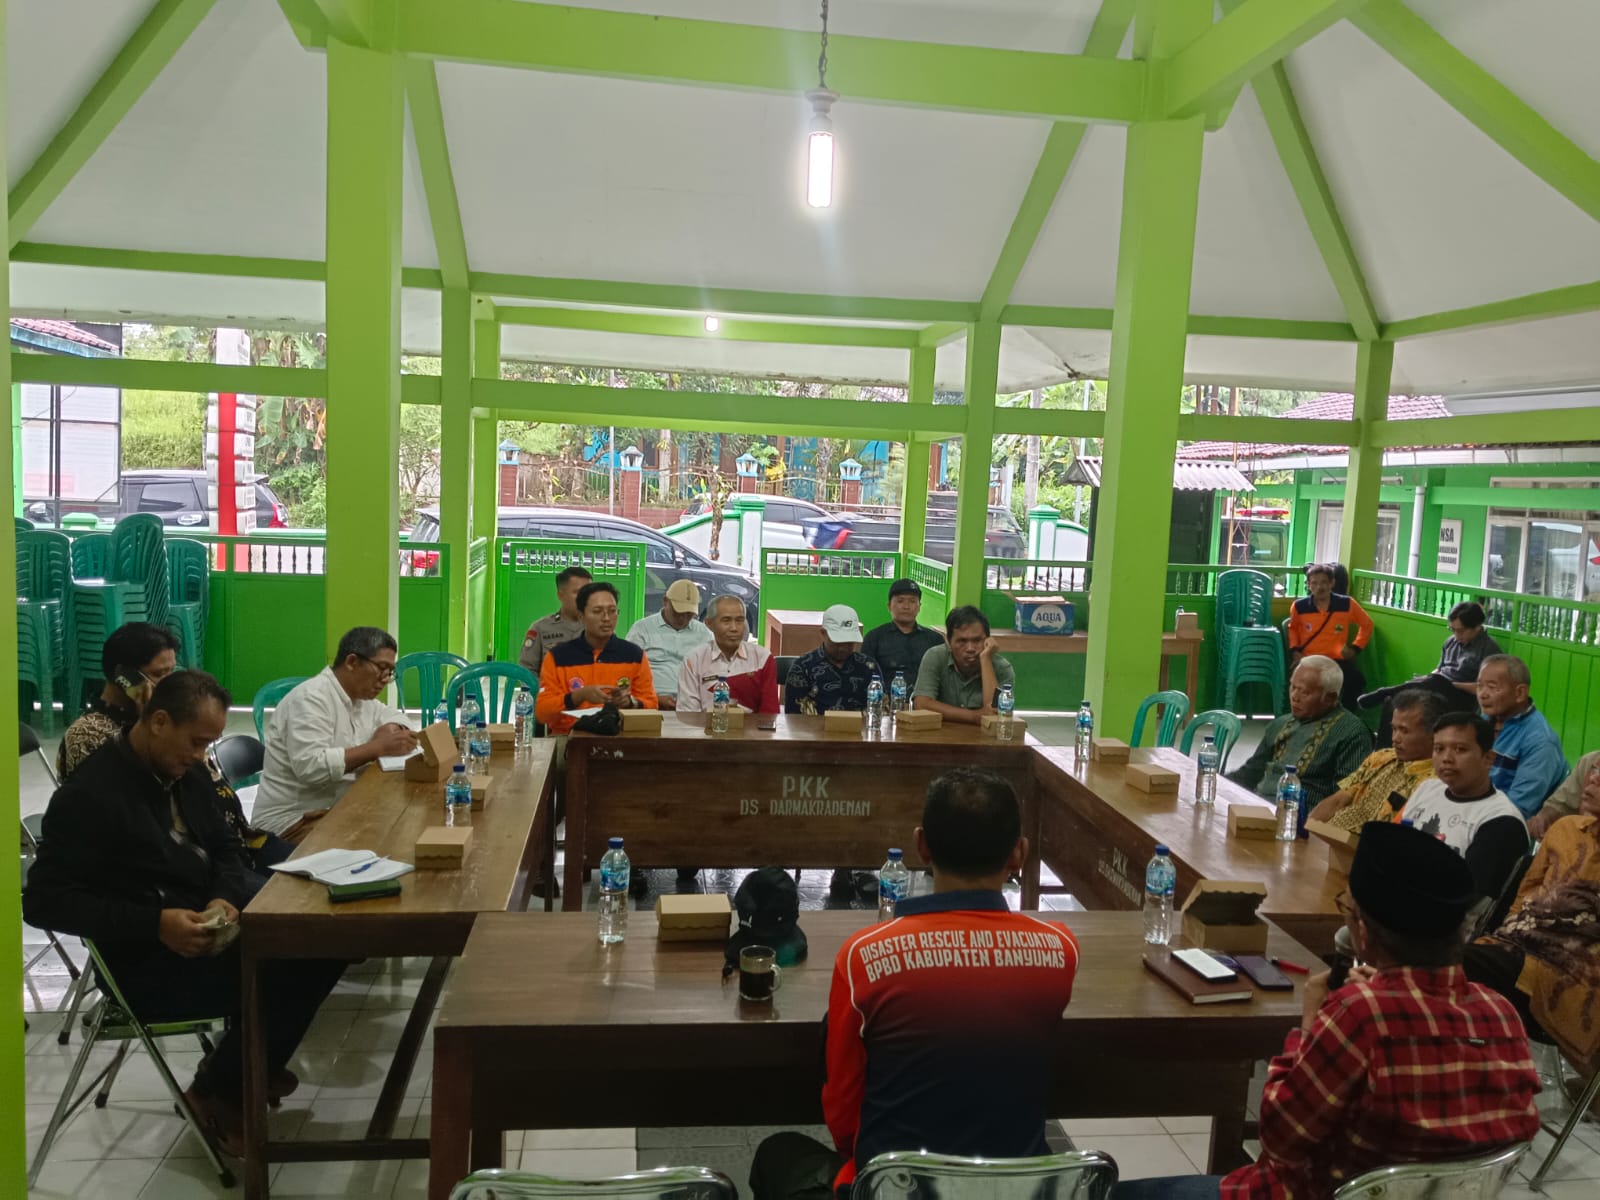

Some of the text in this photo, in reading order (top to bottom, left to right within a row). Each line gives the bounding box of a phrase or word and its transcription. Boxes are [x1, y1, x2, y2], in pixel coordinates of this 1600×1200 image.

[1036, 612, 1062, 623] AQUA
[782, 776, 830, 798] PKK
[770, 799, 871, 816] DARMAKRADENAN
[860, 930, 1063, 964] DISASTER RESCUE AND EVACUATION
[865, 948, 1065, 983] BPBD KABUPATEN BANYUMAS
